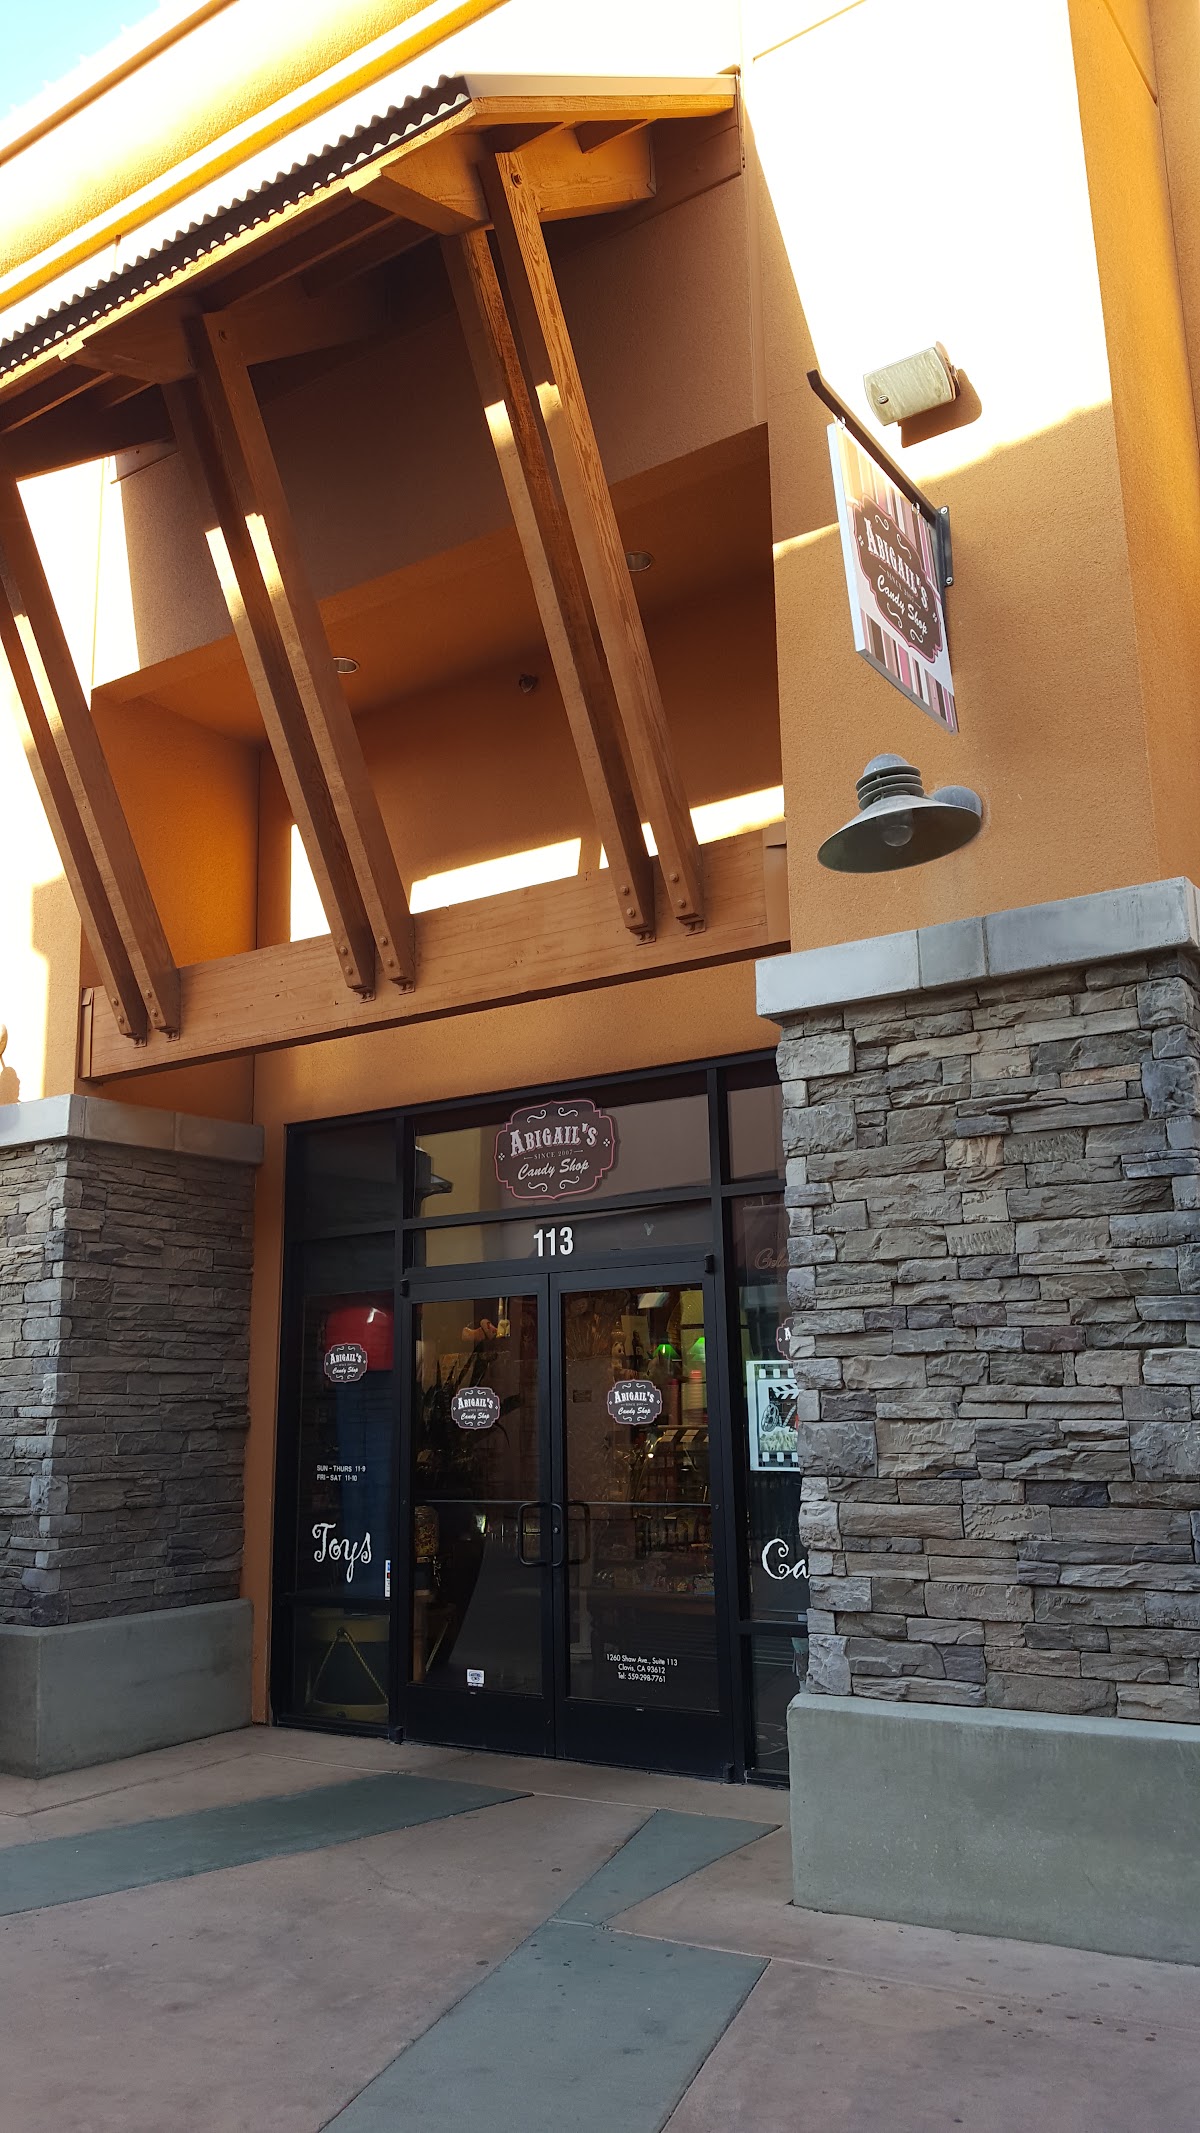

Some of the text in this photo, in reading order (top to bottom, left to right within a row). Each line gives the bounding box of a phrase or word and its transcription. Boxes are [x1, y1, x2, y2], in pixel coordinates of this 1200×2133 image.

[864, 516, 929, 611] ABIGAIL'S
[877, 574, 929, 635] Candy Shop
[510, 1122, 599, 1157] ABIGAIL'S
[534, 1149, 573, 1160] SINCE 2007
[517, 1158, 590, 1180] Candy Shop
[533, 1226, 574, 1257] 113
[330, 1352, 362, 1365] ABIGAIL'S
[332, 1366, 347, 1374] Candy
[458, 1397, 494, 1410] ABIGAIL'S
[614, 1390, 655, 1404] ABIGAIL'S
[460, 1412, 490, 1420] Candy Shop
[617, 1406, 651, 1415] Candy Shop
[355, 1465, 366, 1473] 11-9
[311, 1522, 372, 1583] Toys
[606, 1653, 621, 1662] 1260
[621, 1654, 637, 1663] Shaw
[652, 1657, 666, 1665] Suite
[666, 1658, 678, 1666] 113
[617, 1663, 666, 1674] Clovis, CA 93612
[617, 1671, 627, 1680] Tel:
